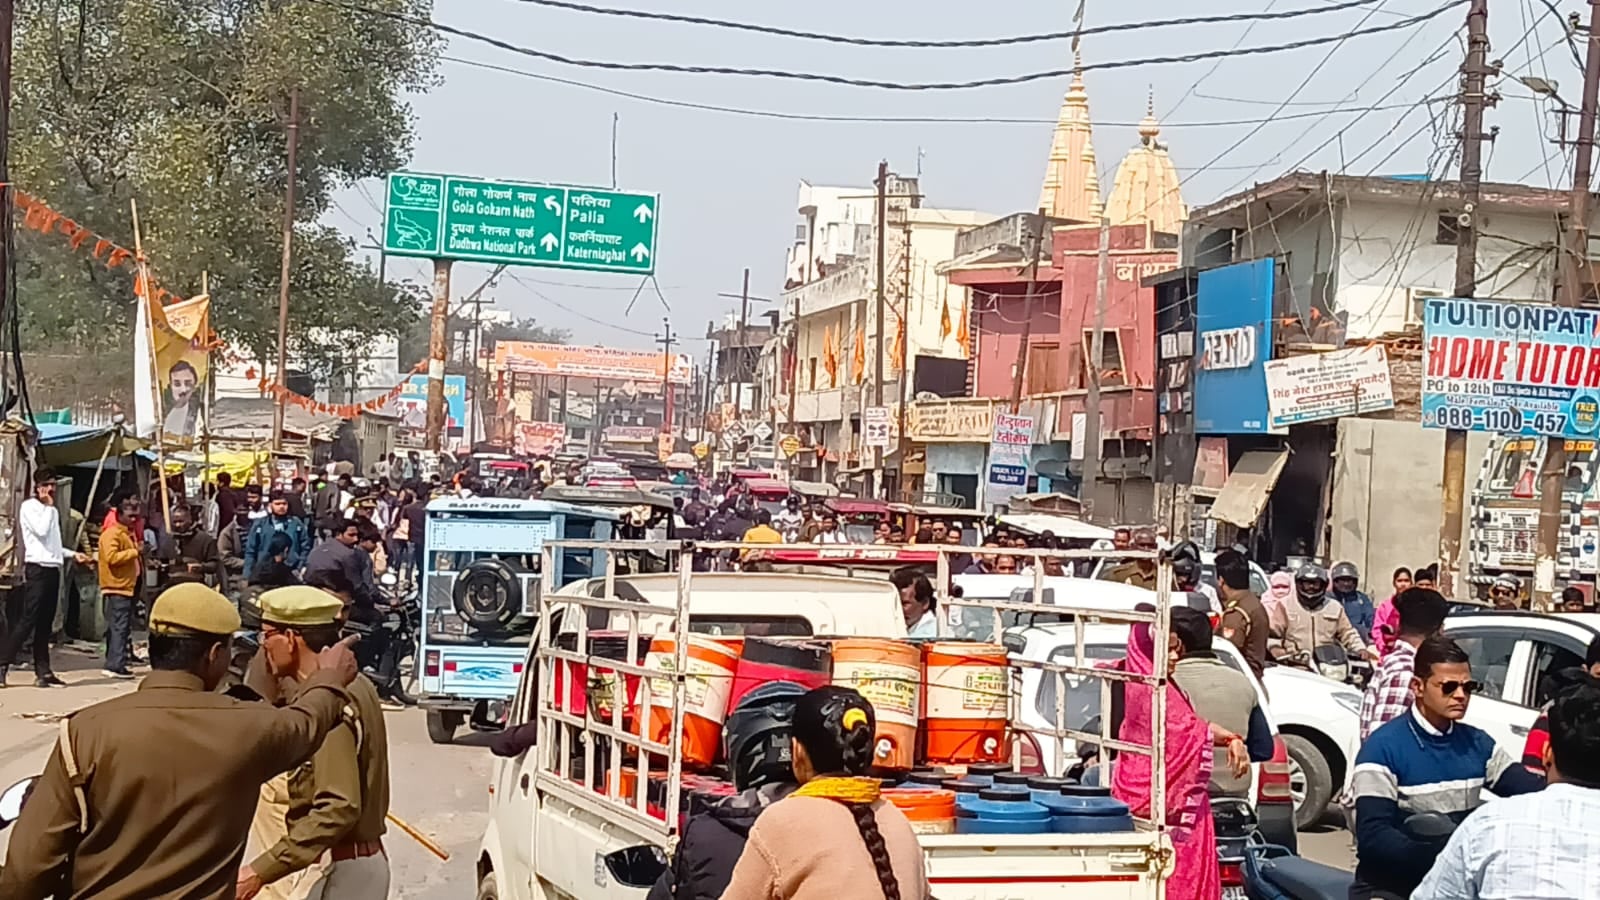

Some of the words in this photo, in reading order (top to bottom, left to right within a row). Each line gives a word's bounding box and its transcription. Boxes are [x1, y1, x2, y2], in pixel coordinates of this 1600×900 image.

[453, 184, 478, 198] गोला
[482, 186, 512, 200] गोकर्ण
[452, 200, 474, 213] Gola
[476, 201, 510, 216] Gokarn
[513, 205, 535, 218] Nath
[571, 194, 611, 208] पलिया
[479, 222, 511, 237] नेशनल
[515, 226, 535, 238] पार्क
[449, 236, 481, 250] Dudhwa
[483, 239, 516, 254] National
[518, 241, 536, 255] Park
[567, 245, 626, 263] Katerniaghat
[1428, 336, 1510, 381] HOME
[1426, 380, 1444, 391] PG
[1448, 382, 1460, 392] to
[1464, 383, 1490, 394] 12th
[1524, 401, 1558, 410] Available
[1437, 407, 1566, 433] 888-1100-457
